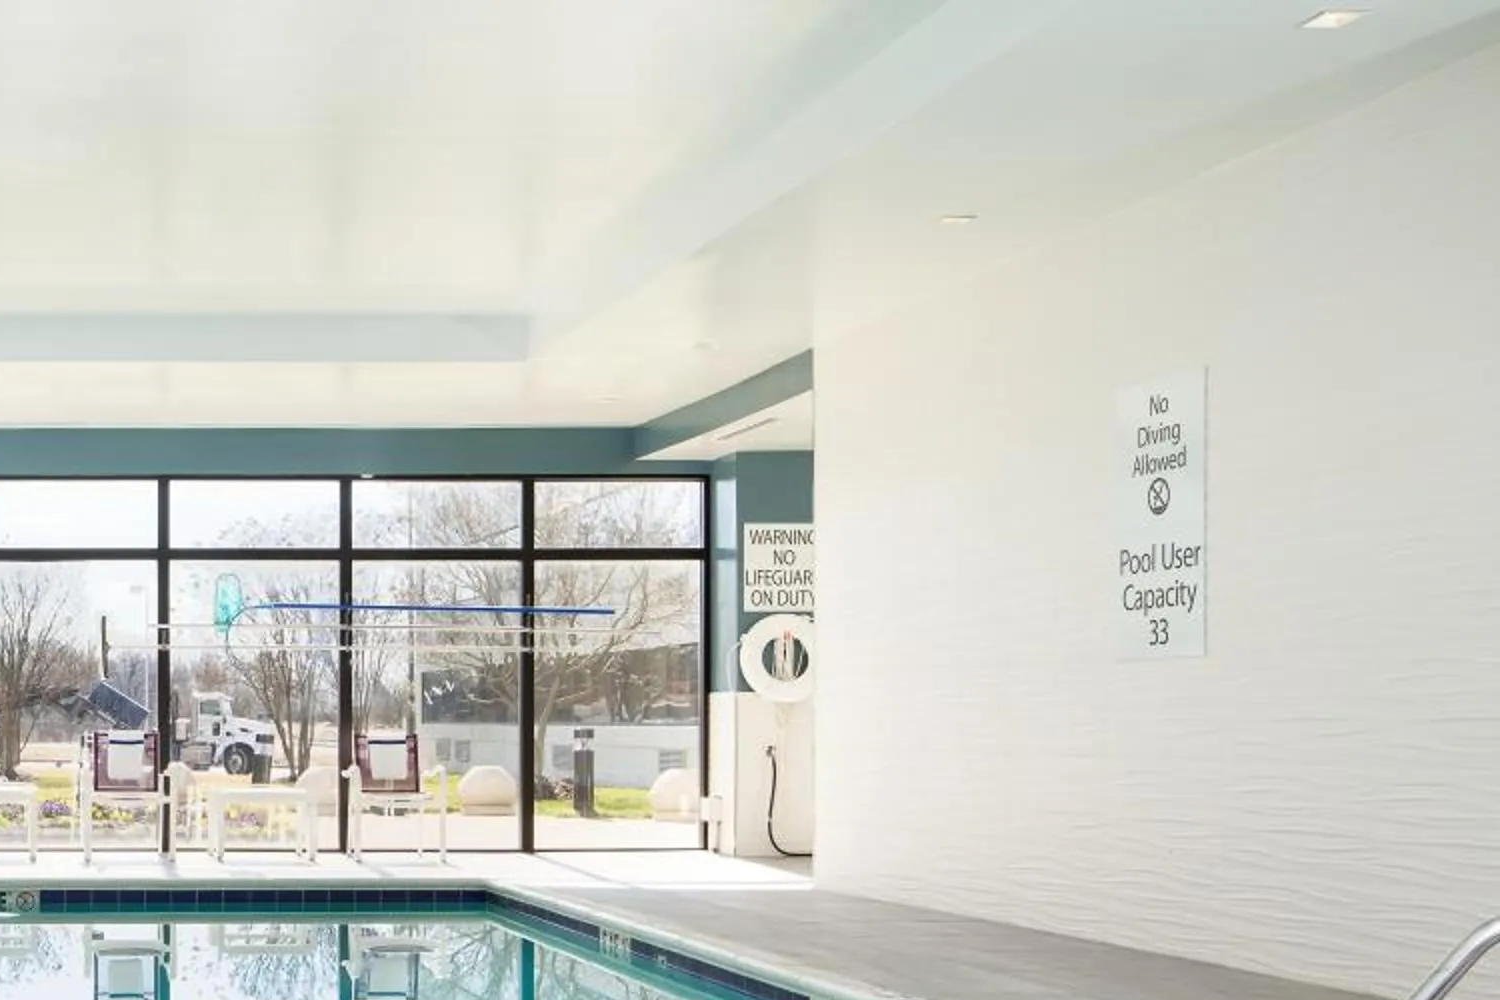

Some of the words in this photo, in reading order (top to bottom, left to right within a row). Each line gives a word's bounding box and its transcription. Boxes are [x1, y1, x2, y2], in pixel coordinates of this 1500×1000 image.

[1149, 395, 1170, 417] No
[1137, 422, 1181, 449] Diving
[1131, 446, 1187, 478] Allowed
[773, 549, 797, 566] NO
[1119, 543, 1156, 576] Pool
[1161, 541, 1201, 571] User
[745, 569, 813, 587] LIFEGUAR
[750, 589, 773, 607] ON
[1122, 579, 1198, 617] Capacity
[1148, 618, 1170, 646] 33
